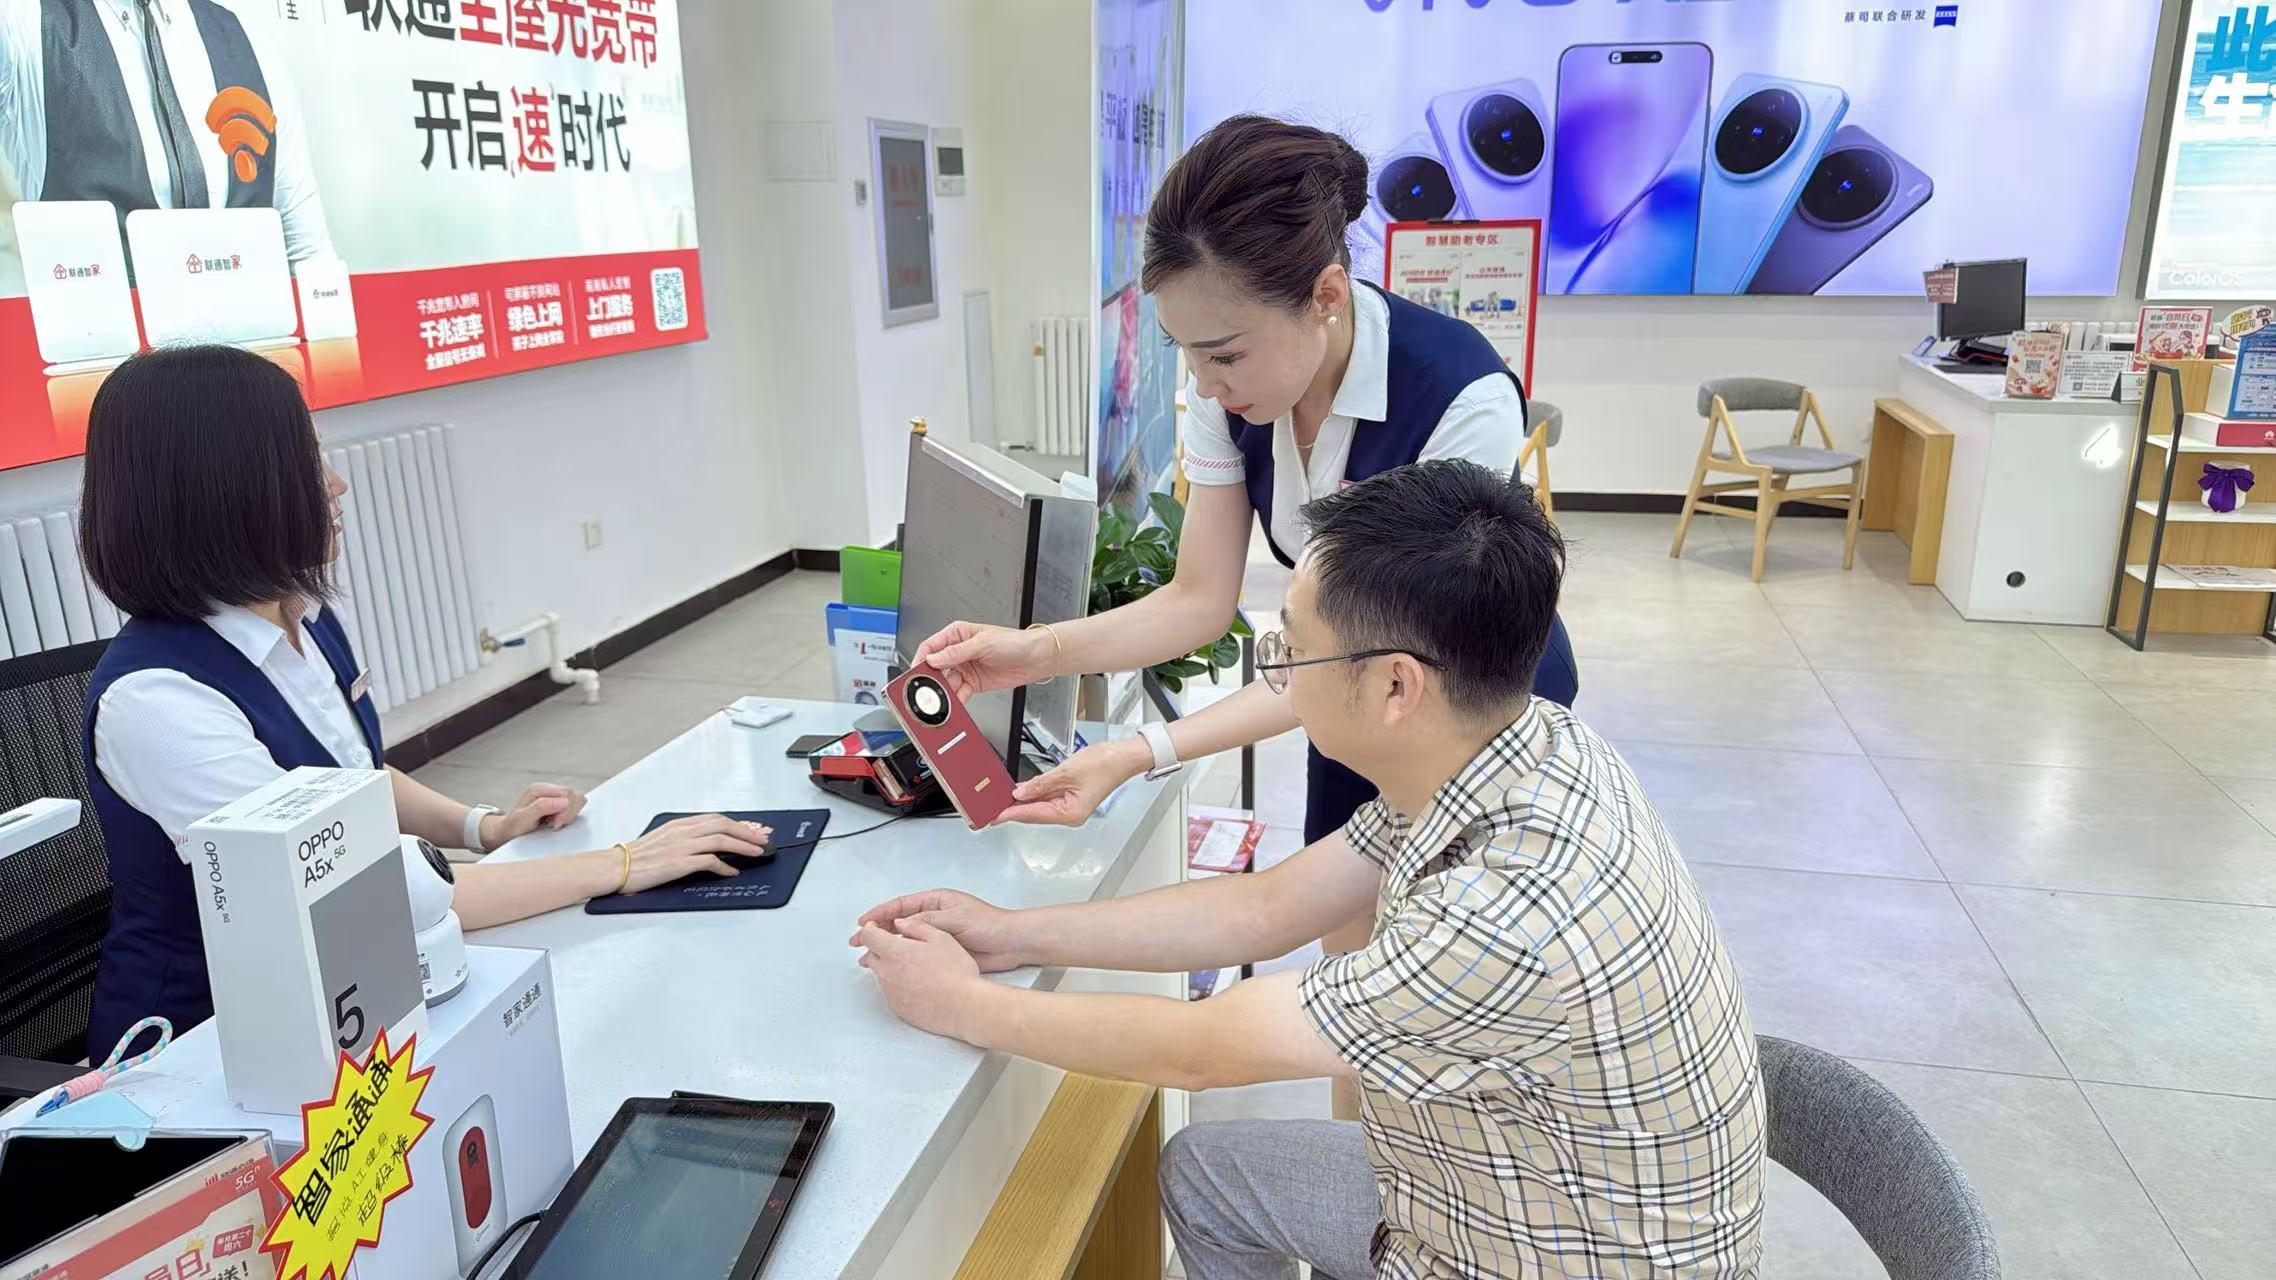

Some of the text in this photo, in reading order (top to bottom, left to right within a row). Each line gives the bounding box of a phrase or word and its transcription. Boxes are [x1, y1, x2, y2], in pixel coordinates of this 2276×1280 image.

[1844, 9, 1926, 23] 蔡司联合研发
[2198, 72, 2276, 138] 生
[1425, 234, 1500, 246] 智慧助老专区
[68, 263, 101, 278] 联通智家
[204, 255, 242, 271] 联通智家
[2168, 270, 2243, 287] ColorOS
[506, 301, 563, 332] 绿色上网
[586, 293, 633, 321] 上门服务
[419, 313, 484, 349] 千兆速率
[298, 821, 345, 862] OPPO
[204, 841, 231, 924] OPPO A5x 5G
[304, 845, 347, 888] A5x 5G
[334, 982, 365, 1050] 5
[503, 982, 542, 1028] 智家通通
[291, 1054, 393, 1227] 智家通通
[356, 1133, 409, 1228] 超级棒
[223, 1240, 242, 1252] 周六
